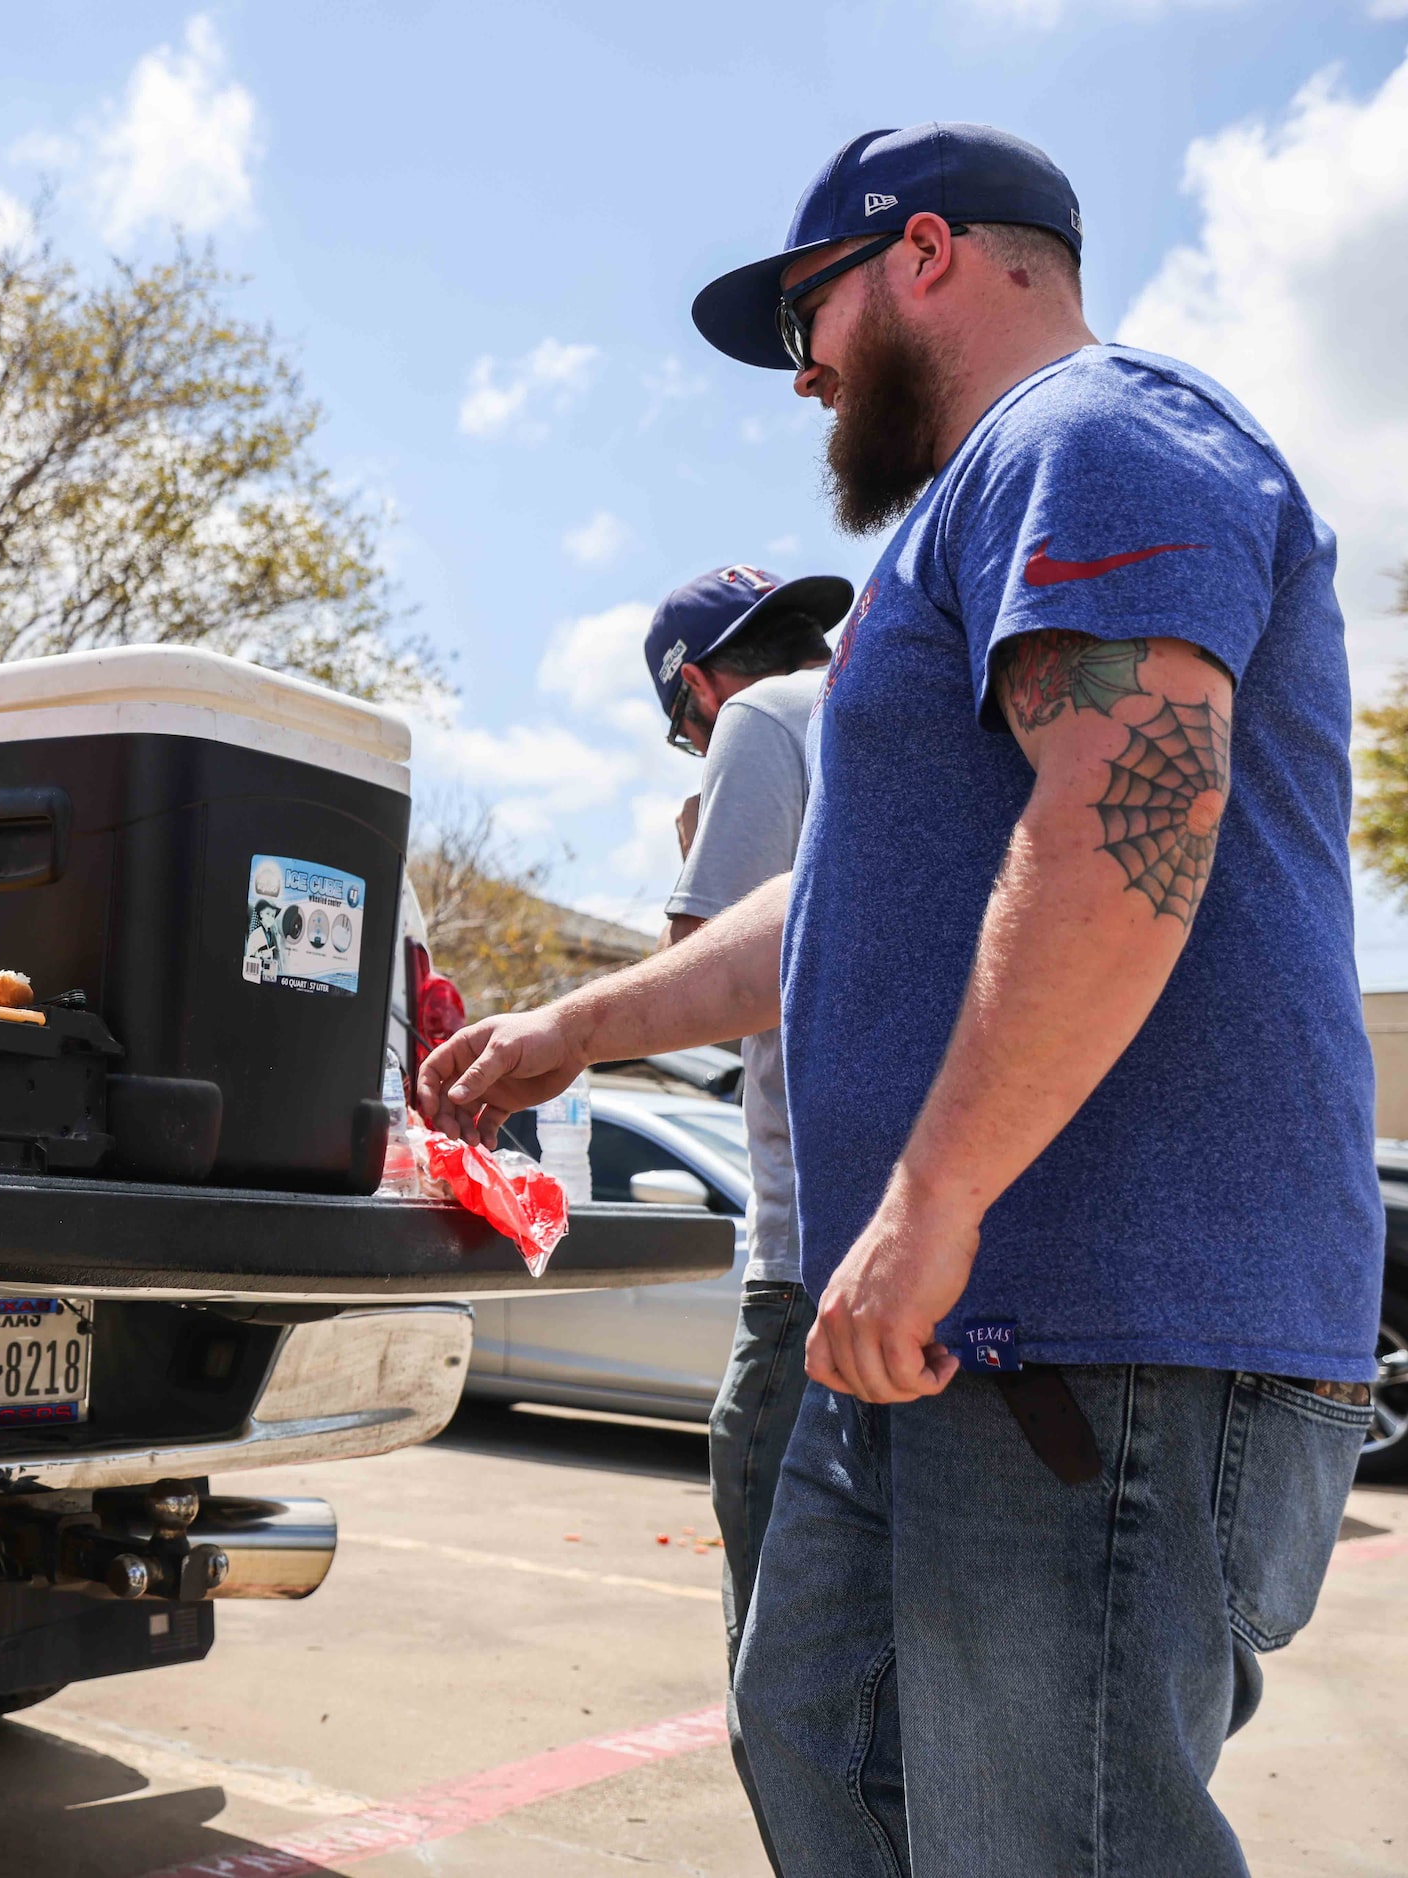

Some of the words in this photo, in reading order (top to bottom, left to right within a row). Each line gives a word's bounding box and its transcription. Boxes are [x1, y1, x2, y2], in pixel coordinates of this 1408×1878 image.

[285, 868, 309, 892] ICE
[309, 874, 343, 899] CUBE
[281, 977, 289, 986] 60
[289, 978, 307, 989] QUART
[309, 982, 316, 990] 57
[316, 983, 330, 993] LITER
[966, 1326, 1011, 1343] TEXAS
[5, 1340, 80, 1397] 8218
